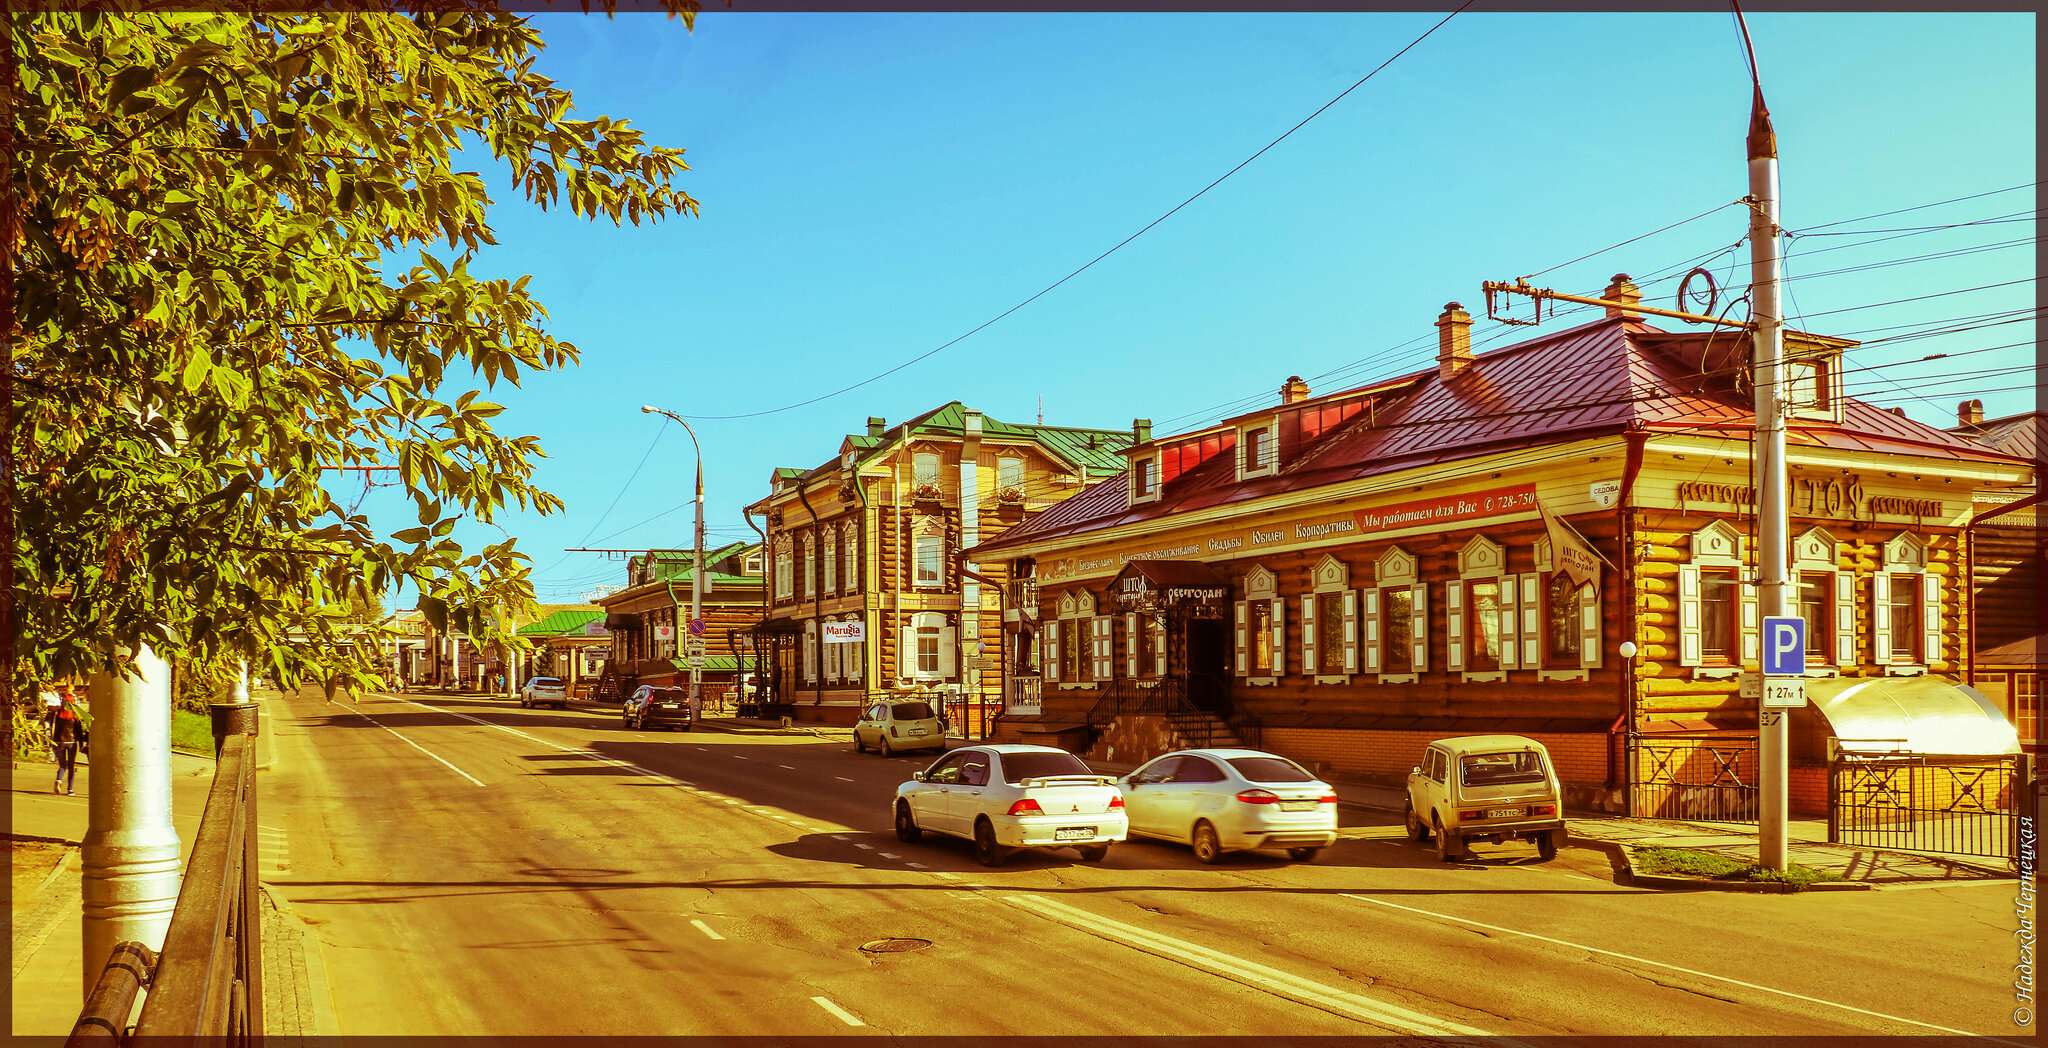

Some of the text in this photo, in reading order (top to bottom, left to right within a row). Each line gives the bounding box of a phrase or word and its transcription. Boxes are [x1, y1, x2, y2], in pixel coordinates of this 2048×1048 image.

[1594, 485, 1619, 495] СЕДОВА
[1603, 495, 1609, 505] 8
[1790, 474, 1863, 519] ТОФ
[1363, 491, 1535, 529] Мы работаем для Вас 728-750
[1079, 557, 1114, 571] Бизнес-ланч
[1208, 537, 1242, 551] Свадьбы
[1295, 520, 1354, 540] Корпоративы
[1168, 588, 1223, 605] ресторан
[1775, 624, 1798, 669] P
